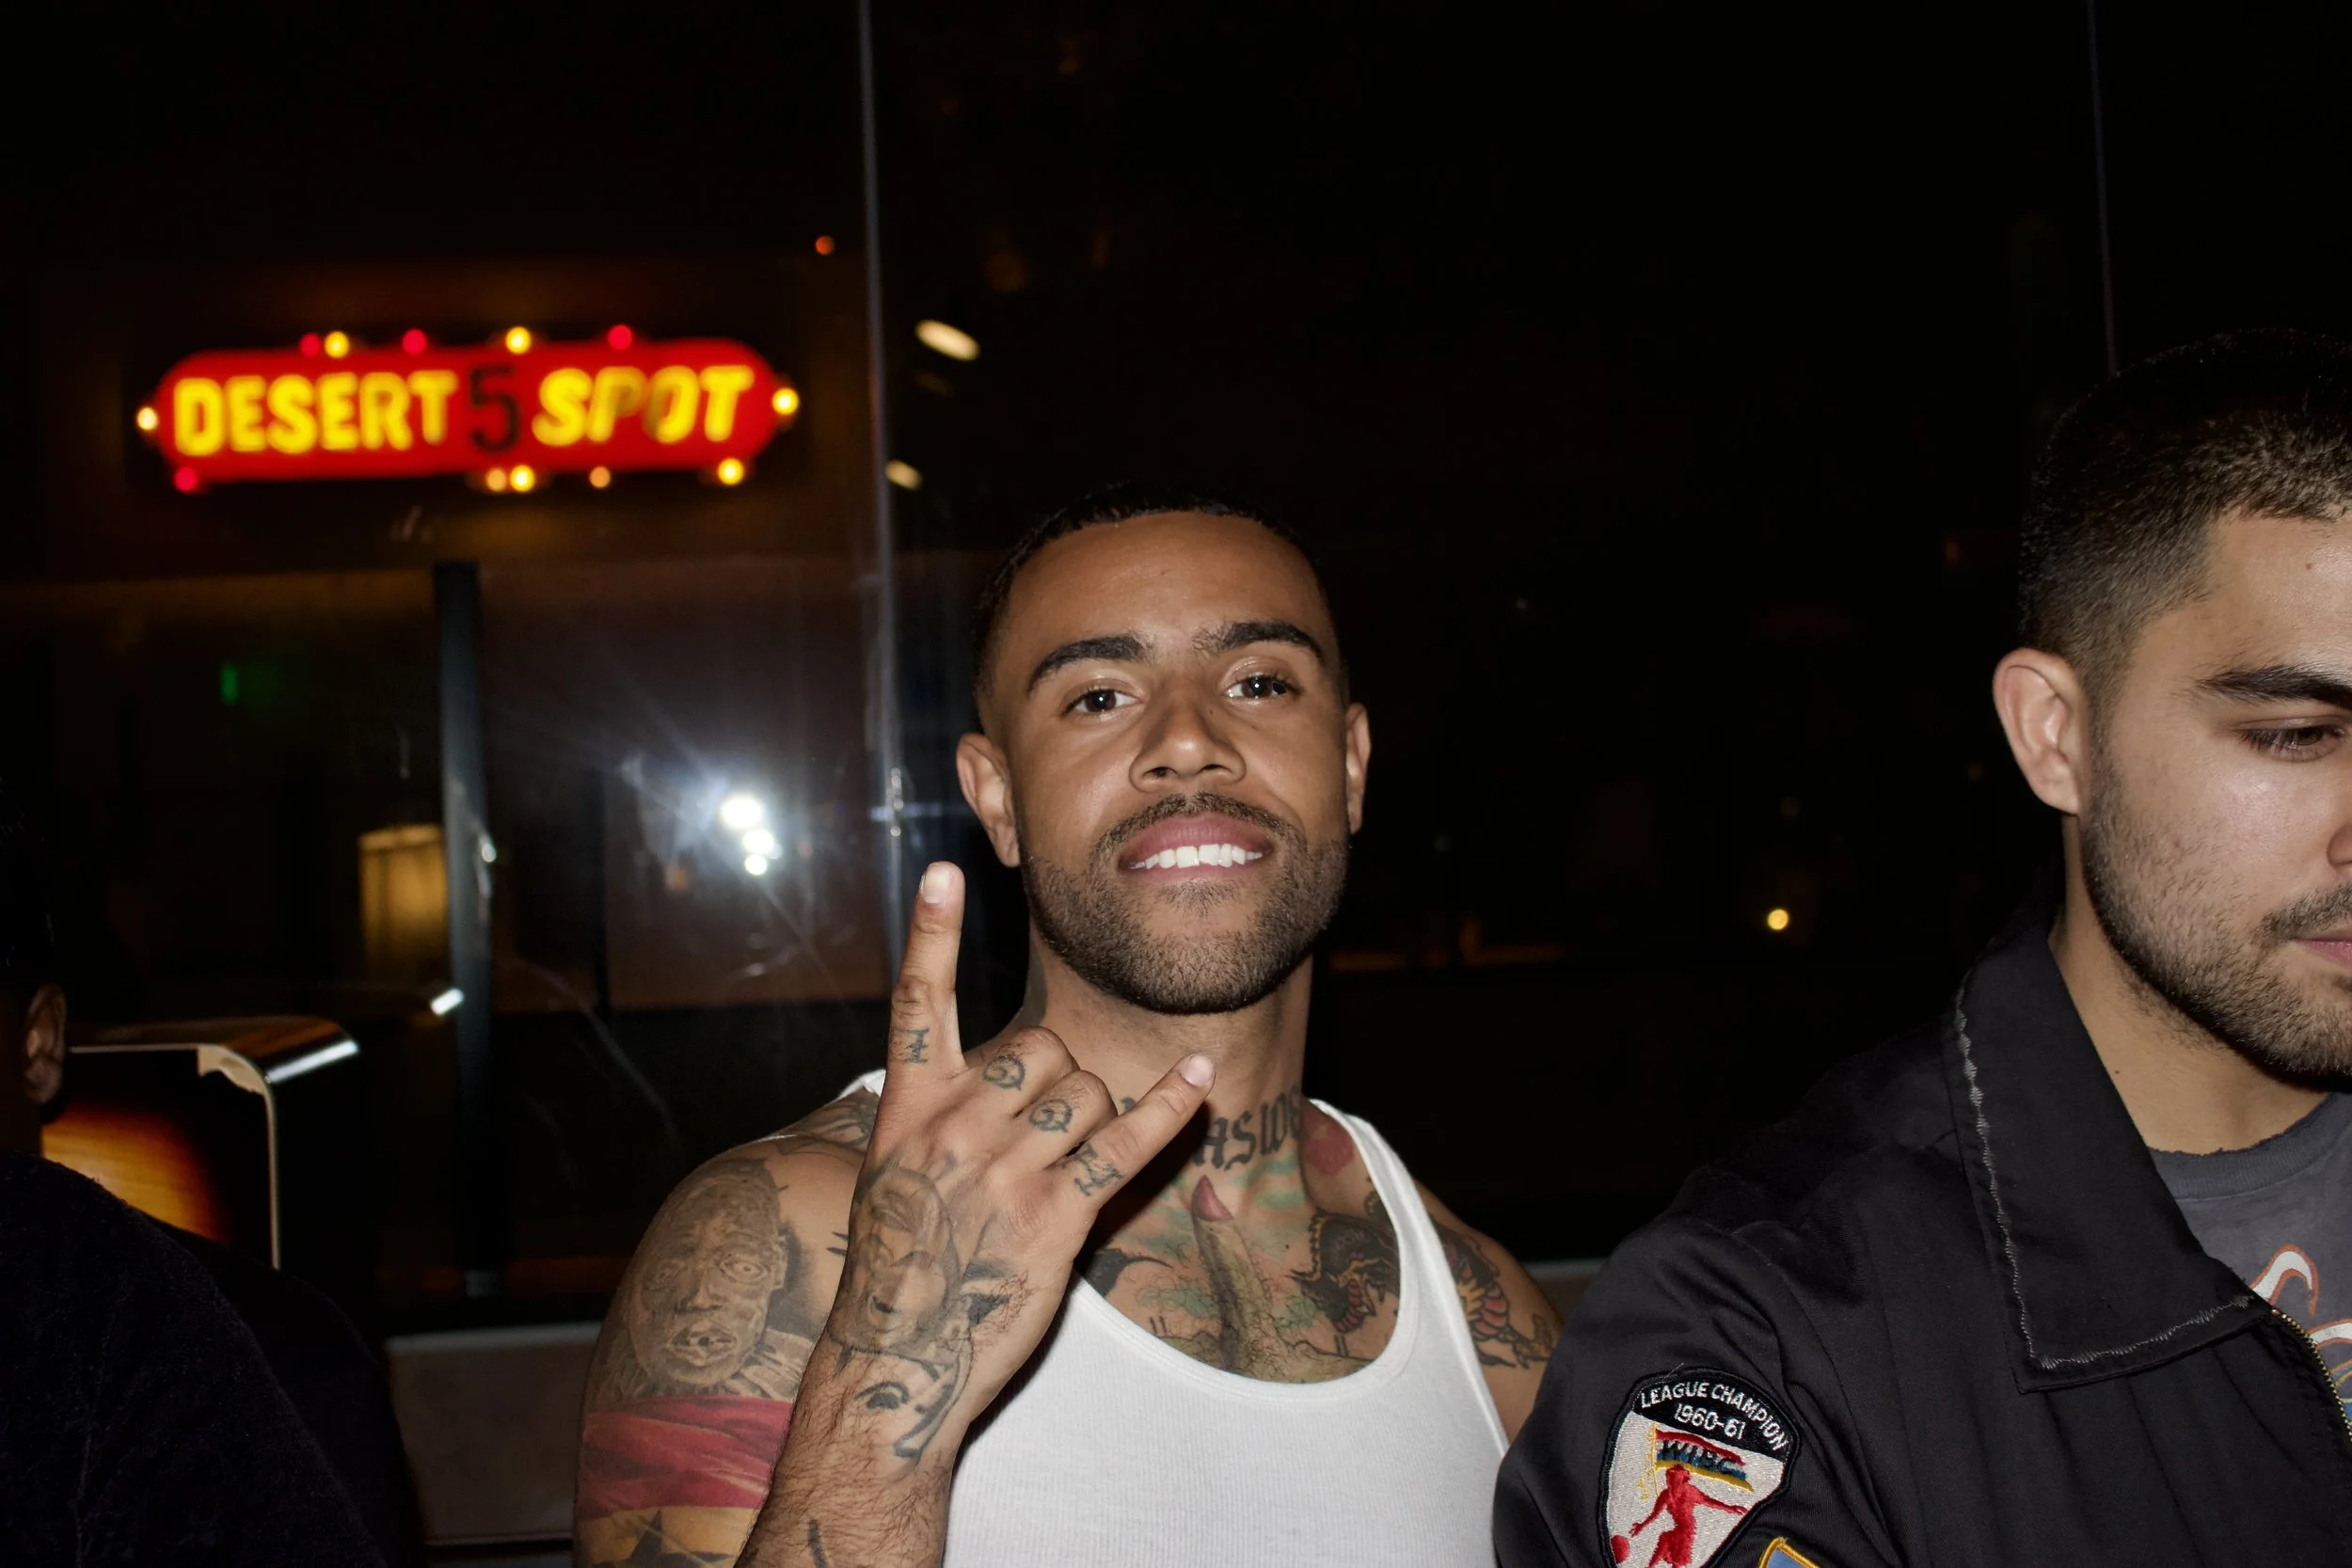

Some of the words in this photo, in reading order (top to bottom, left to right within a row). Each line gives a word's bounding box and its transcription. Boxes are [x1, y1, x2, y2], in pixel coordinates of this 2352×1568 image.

[173, 370, 458, 455] DESERT
[469, 365, 519, 452] 5
[532, 364, 755, 447] SPOT
[1641, 1382, 1709, 1408] LEAGUE
[1711, 1384, 1788, 1451] CHAMPION
[1674, 1402, 1746, 1439] 1960-61
